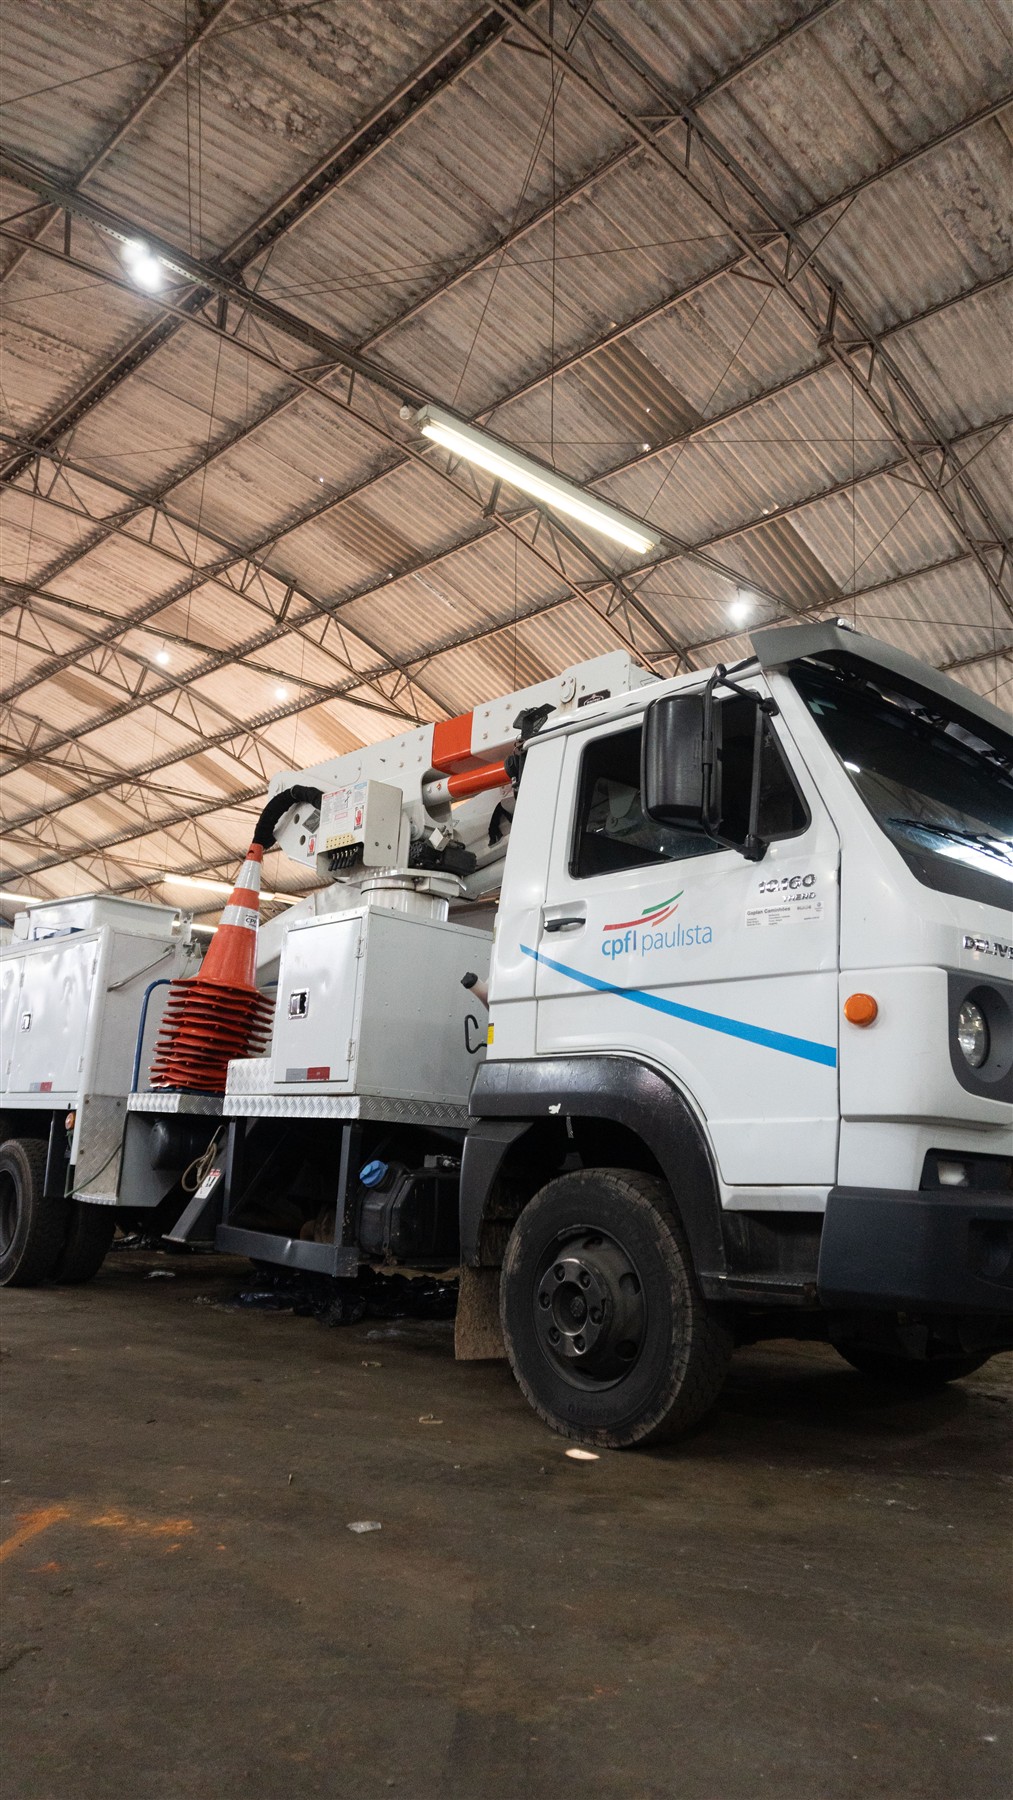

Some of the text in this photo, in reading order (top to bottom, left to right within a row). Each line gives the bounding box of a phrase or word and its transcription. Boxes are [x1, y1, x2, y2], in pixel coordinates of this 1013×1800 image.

[759, 874, 816, 893] 10.160
[601, 923, 713, 961] cpfl paulista
